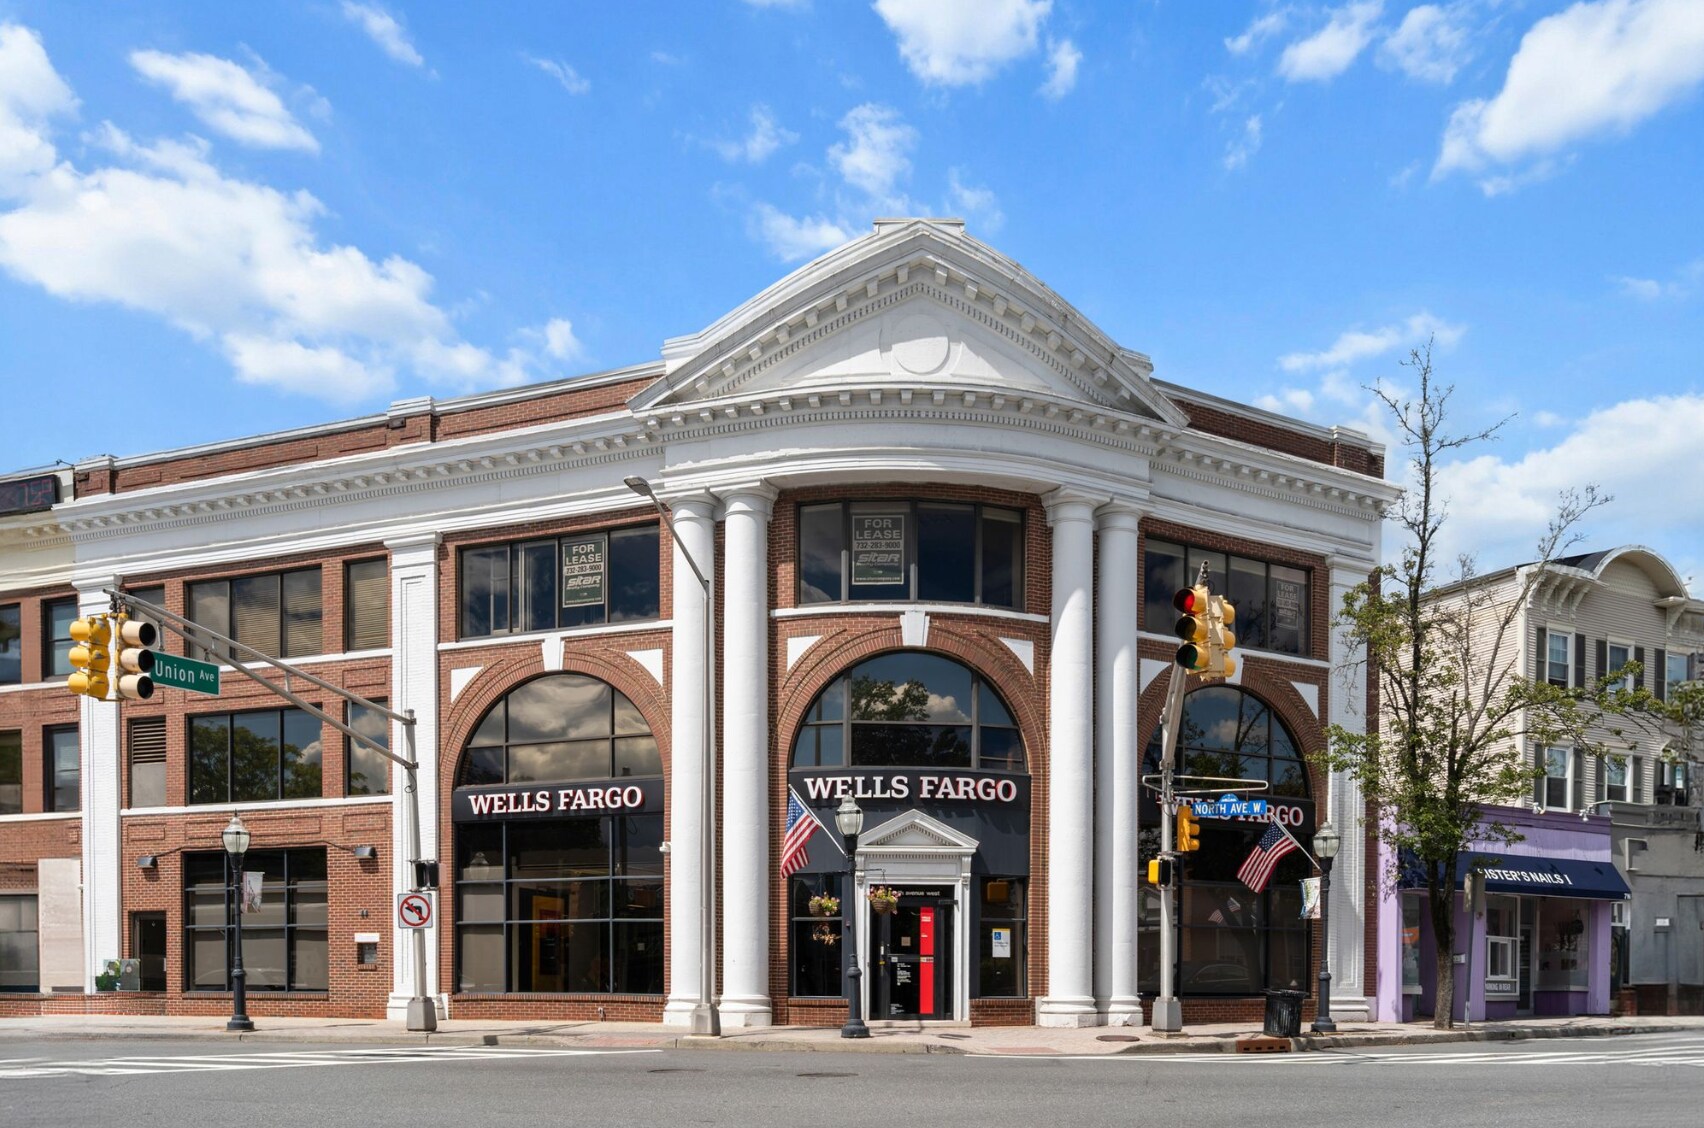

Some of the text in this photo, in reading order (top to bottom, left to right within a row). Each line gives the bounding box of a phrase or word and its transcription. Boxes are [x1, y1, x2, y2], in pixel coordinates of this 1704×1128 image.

[865, 519, 892, 528] FOR
[856, 530, 901, 540] LEASE
[572, 544, 595, 555] FOR
[566, 553, 602, 565] LEASE
[155, 659, 215, 684] Union Ave
[804, 775, 1018, 802] WELLS FARGO
[468, 786, 643, 815] WELLS FARGO
[1194, 803, 1227, 815] NORTH
[1230, 804, 1251, 814] AVE.
[1253, 802, 1264, 813] W.
[1529, 873, 1565, 884] NAILS
